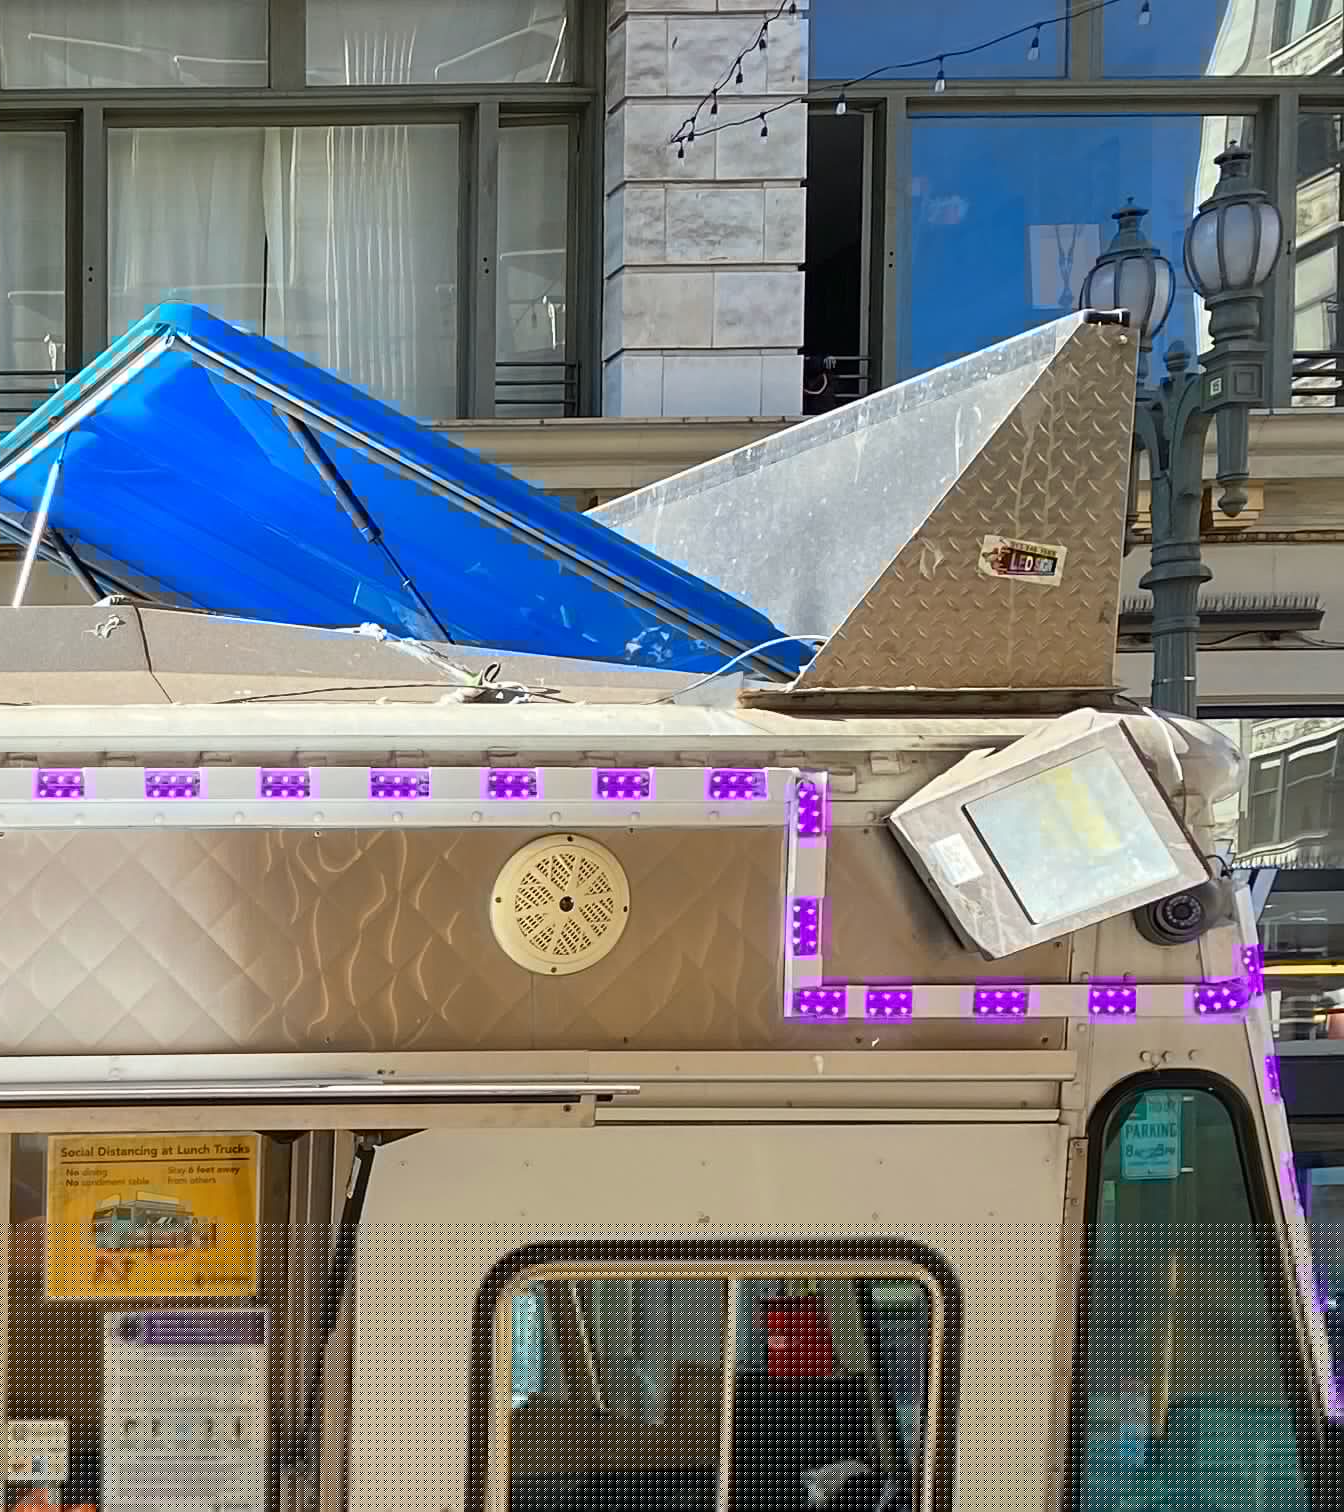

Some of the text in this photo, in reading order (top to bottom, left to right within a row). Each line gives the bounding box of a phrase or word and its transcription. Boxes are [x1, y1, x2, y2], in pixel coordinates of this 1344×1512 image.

[61, 1143, 250, 1158] Social Distancing at Lunch Trucks
